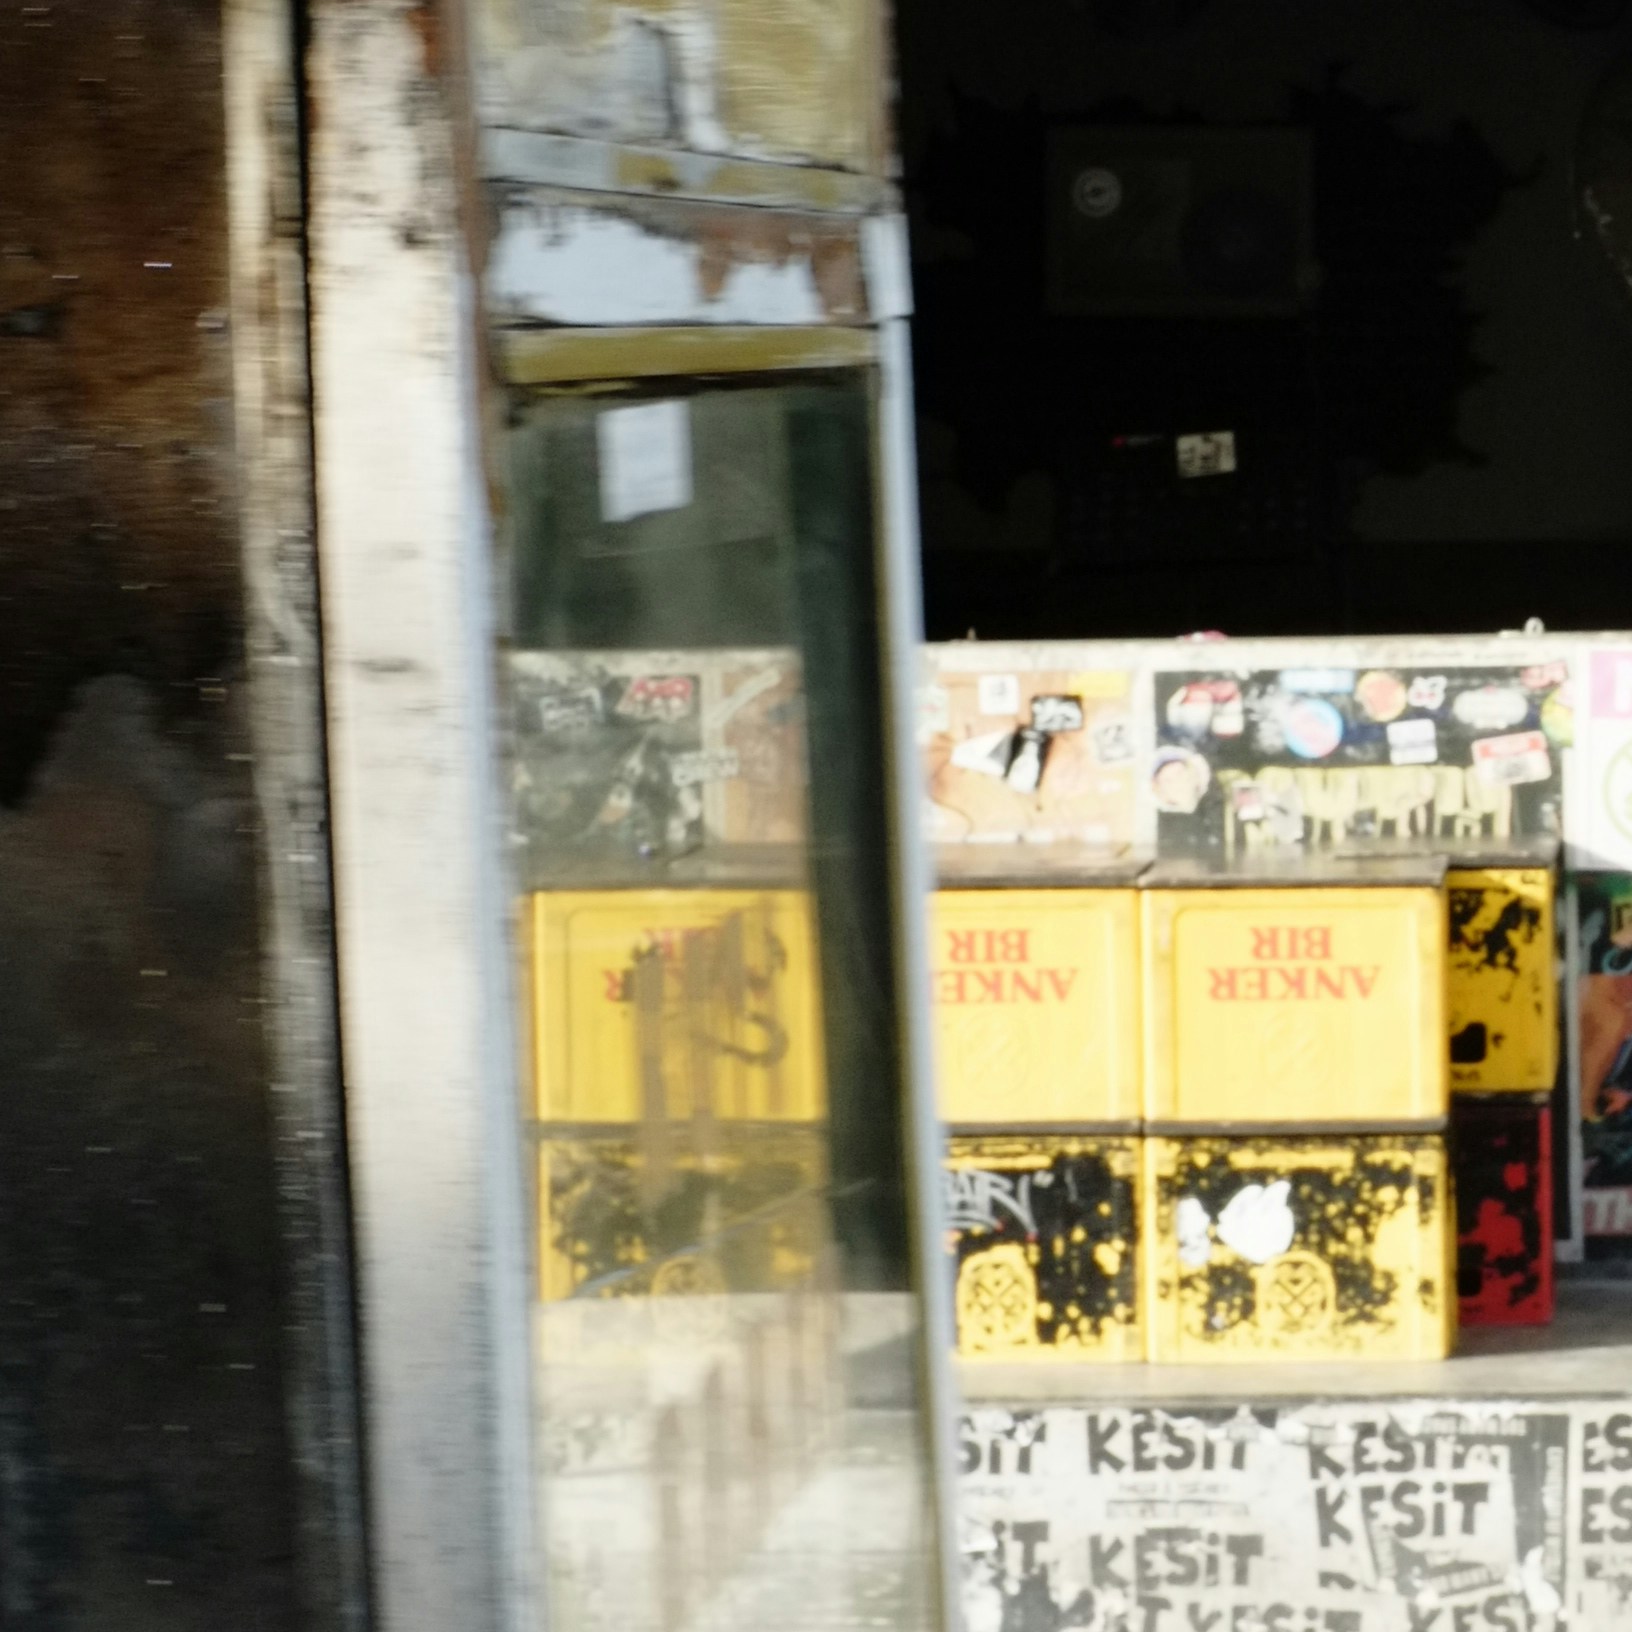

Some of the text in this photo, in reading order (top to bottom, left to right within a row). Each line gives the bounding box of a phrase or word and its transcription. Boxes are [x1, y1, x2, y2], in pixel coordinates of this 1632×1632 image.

[946, 928, 1032, 964] BIR
[1250, 925, 1334, 961] BIR
[933, 967, 1079, 1005] ANKE
[1207, 965, 1382, 1002] ANKER
